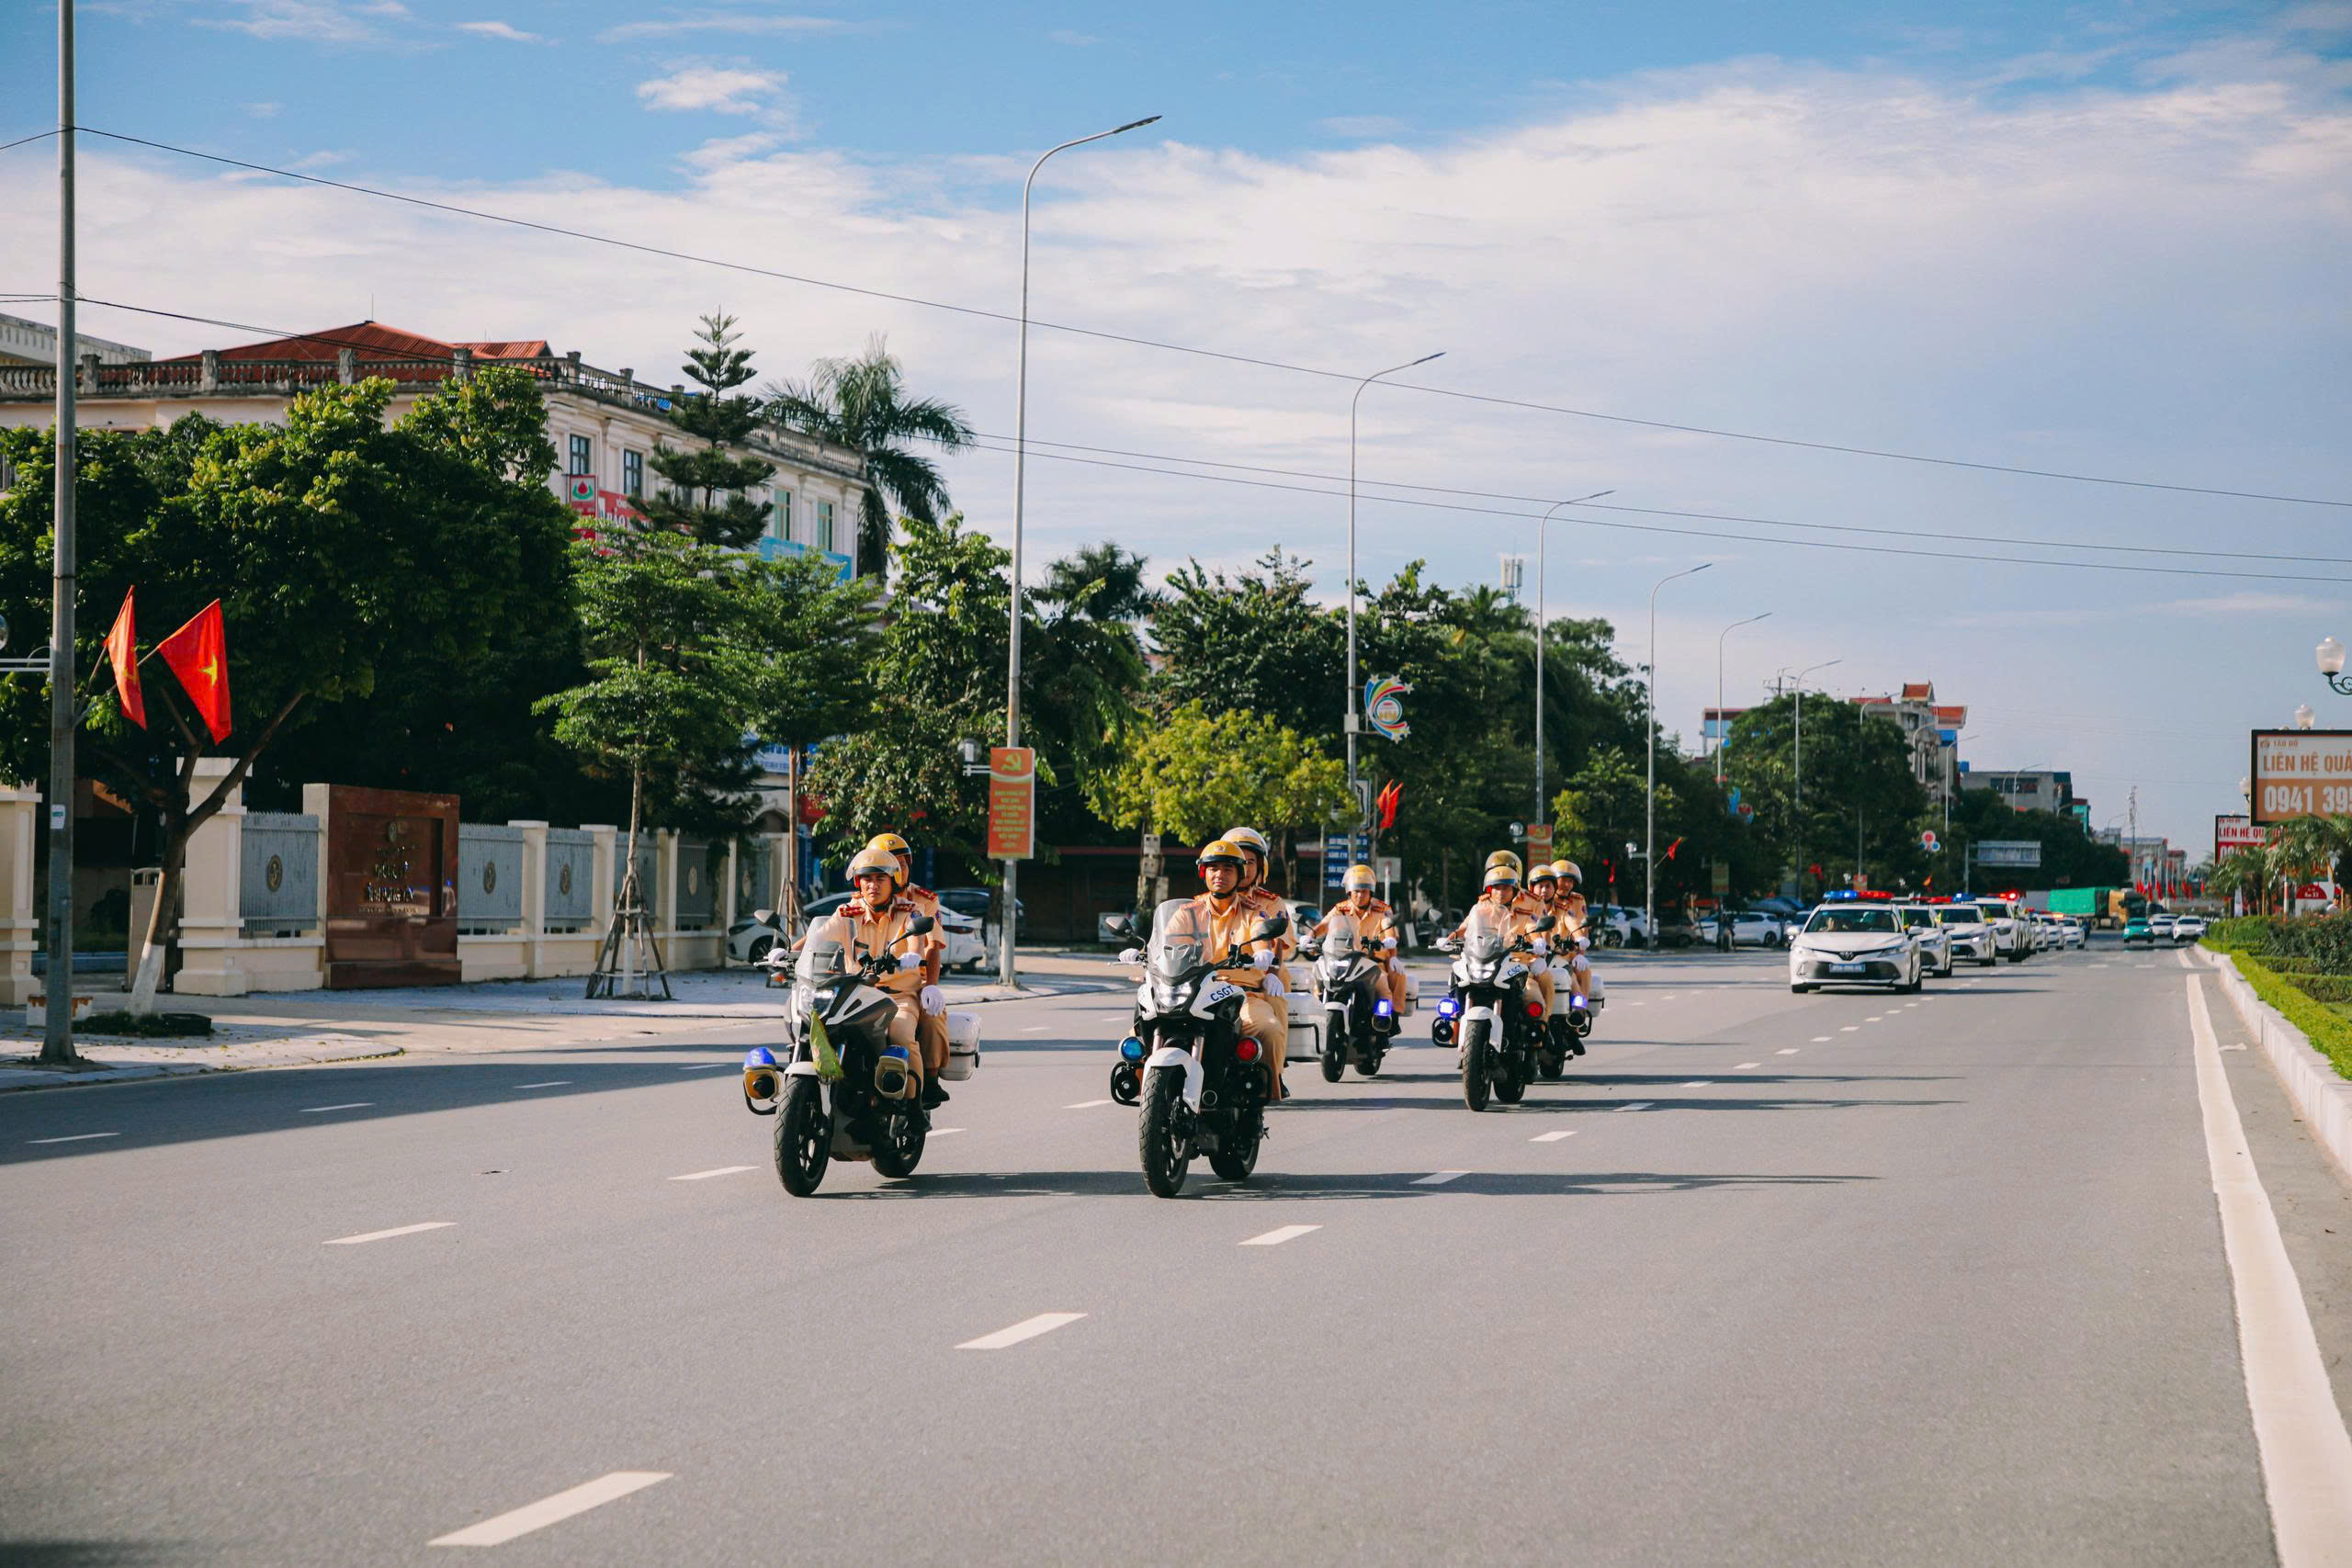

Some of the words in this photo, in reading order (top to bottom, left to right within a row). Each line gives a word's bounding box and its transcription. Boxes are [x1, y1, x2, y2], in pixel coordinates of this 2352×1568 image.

[2263, 751, 2295, 772] LIÊN
[2301, 750, 2319, 776] HỆ
[2264, 785, 2313, 813] 0941
[2323, 785, 2352, 813] 39
[1210, 985, 1234, 1001] CSGT
